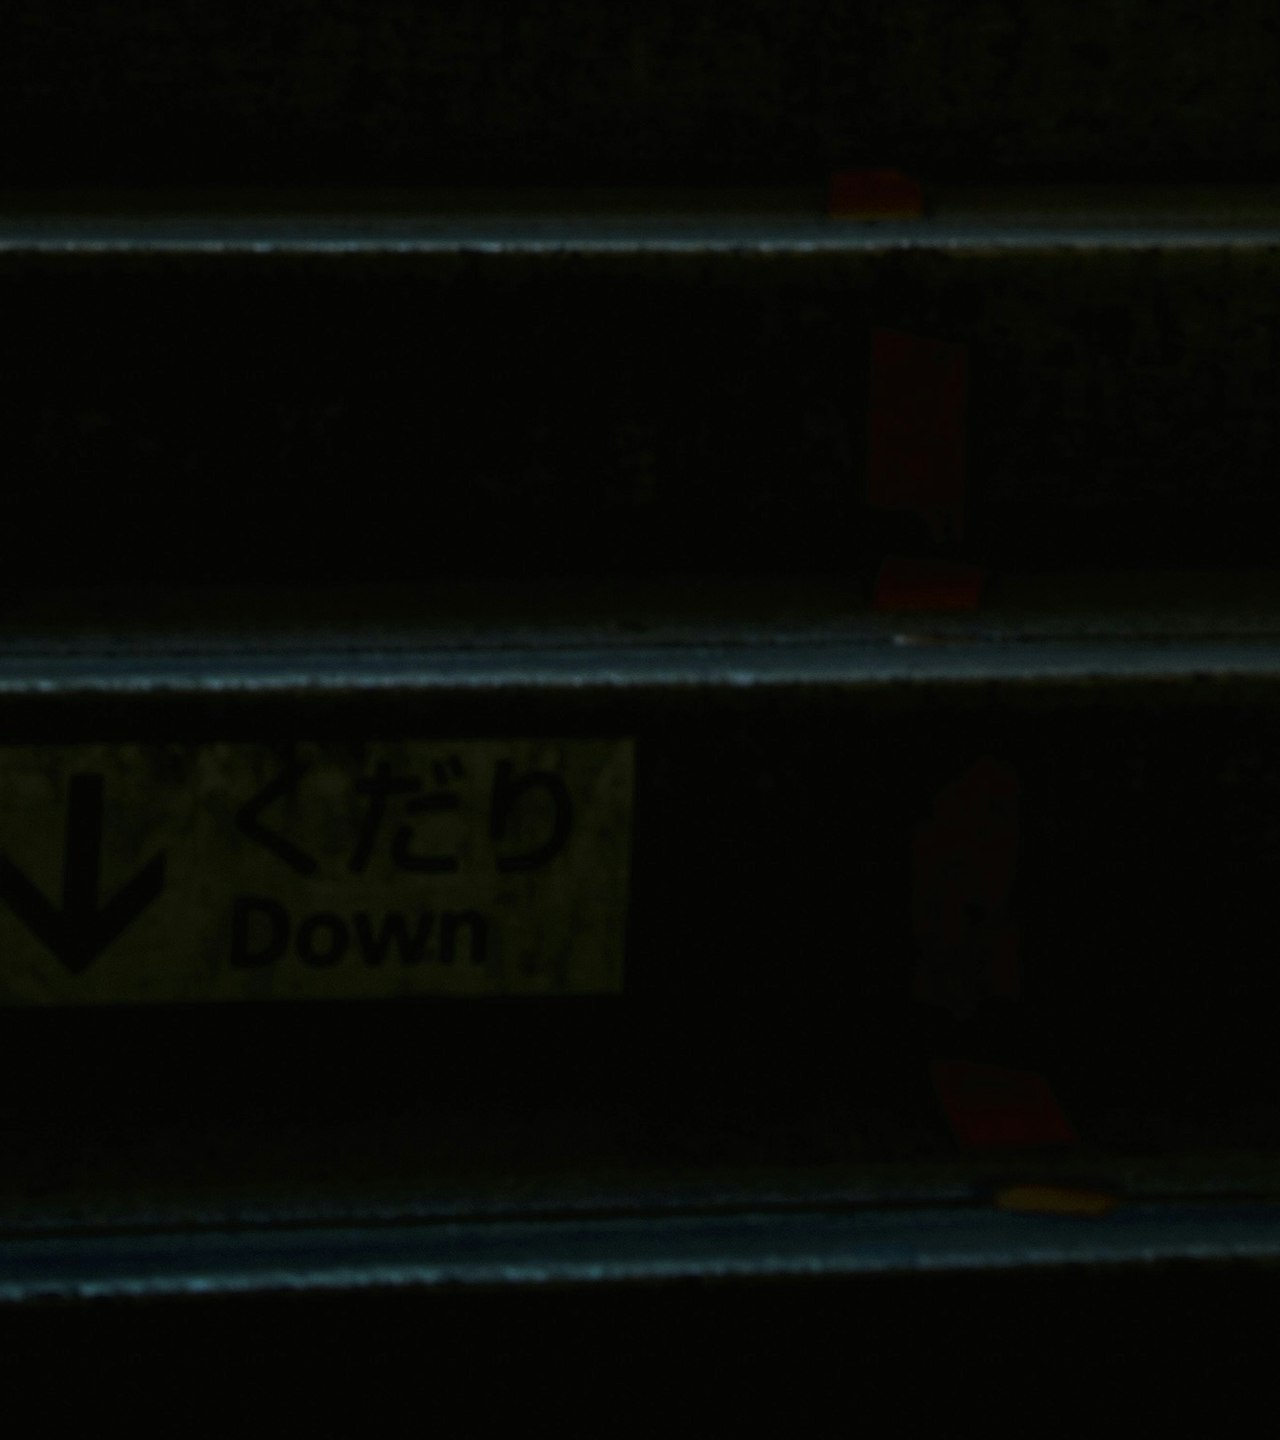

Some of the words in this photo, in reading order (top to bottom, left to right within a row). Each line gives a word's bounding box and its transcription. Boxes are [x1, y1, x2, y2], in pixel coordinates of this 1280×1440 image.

[235, 757, 575, 876] くだり
[229, 897, 489, 968] Down
